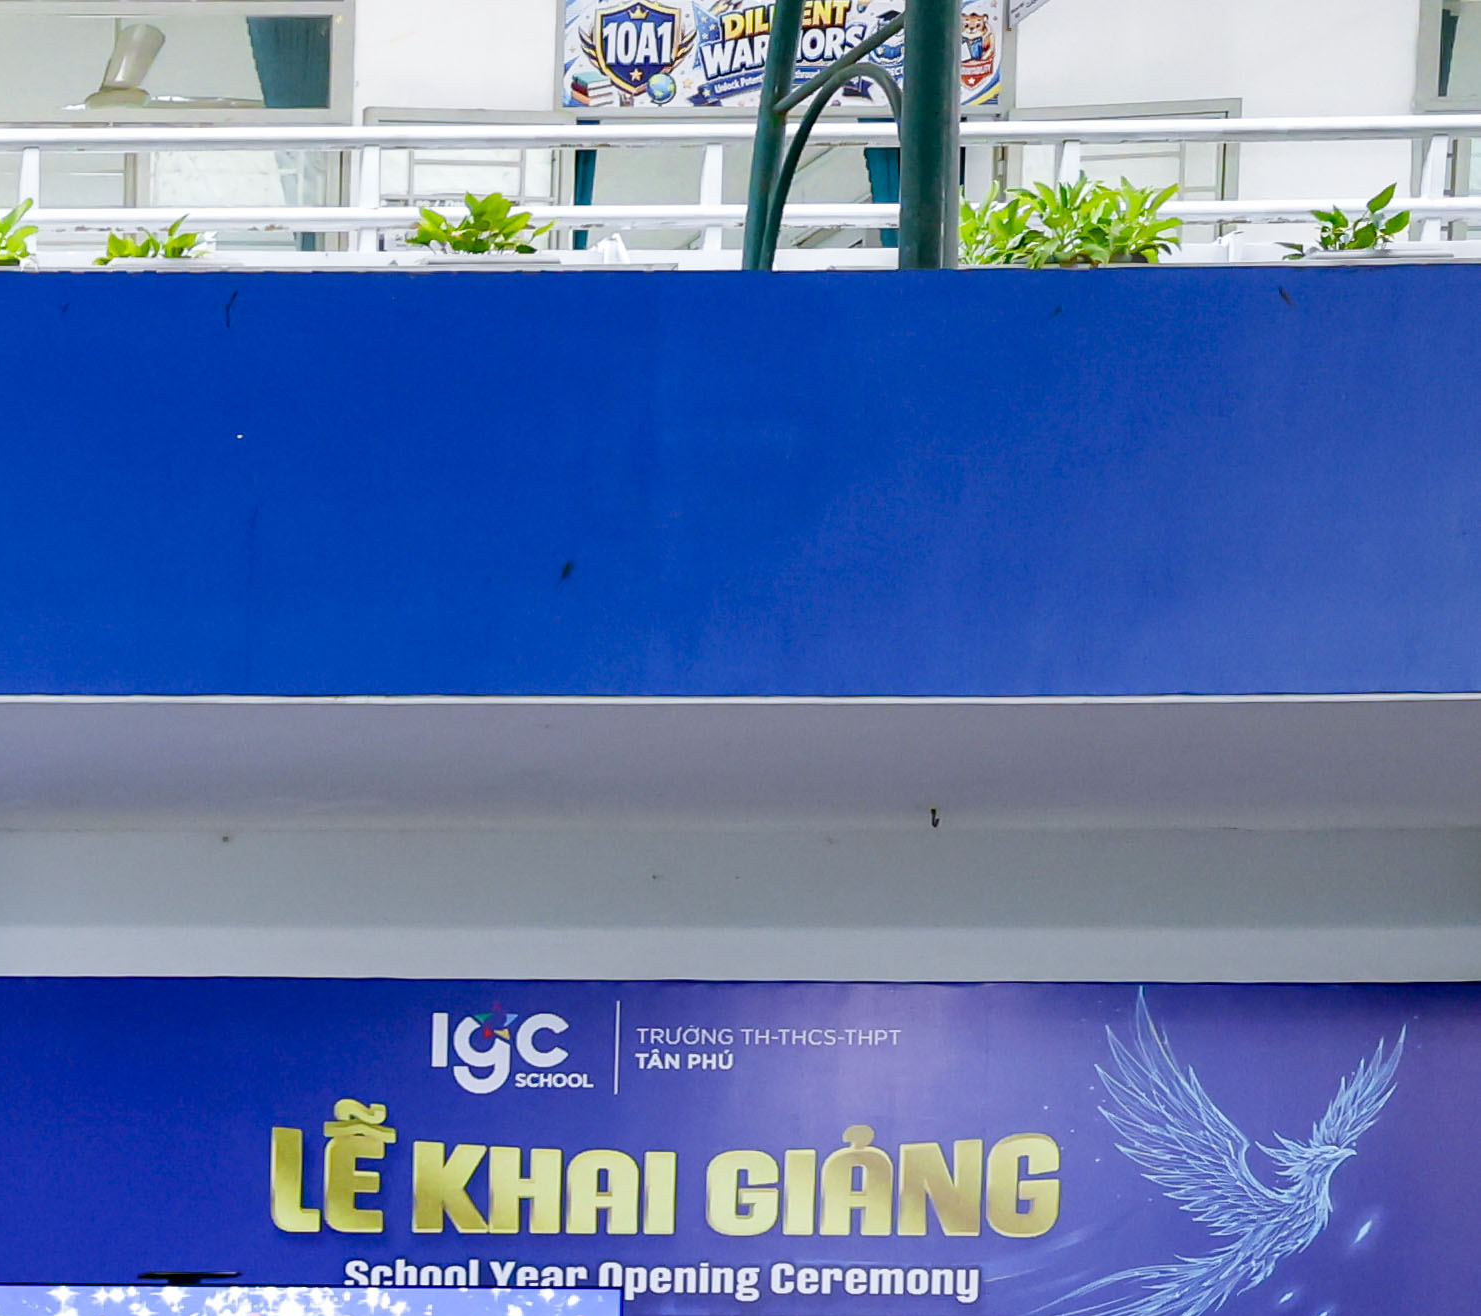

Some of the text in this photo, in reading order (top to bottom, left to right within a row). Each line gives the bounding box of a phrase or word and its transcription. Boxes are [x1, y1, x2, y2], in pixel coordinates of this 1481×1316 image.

[722, 0, 848, 39] DILENT
[602, 21, 675, 65] 10A1
[702, 24, 864, 78] WARIORS
[636, 1025, 902, 1048] TRƯỜNG TH-THCS-THPT
[635, 1049, 735, 1071] TÂN PHÚ
[515, 1073, 595, 1090] SCHOOL
[271, 1099, 1063, 1239] LỄ KHAI GIẢNG
[344, 1259, 981, 1303] School Year Opening Ceremony
